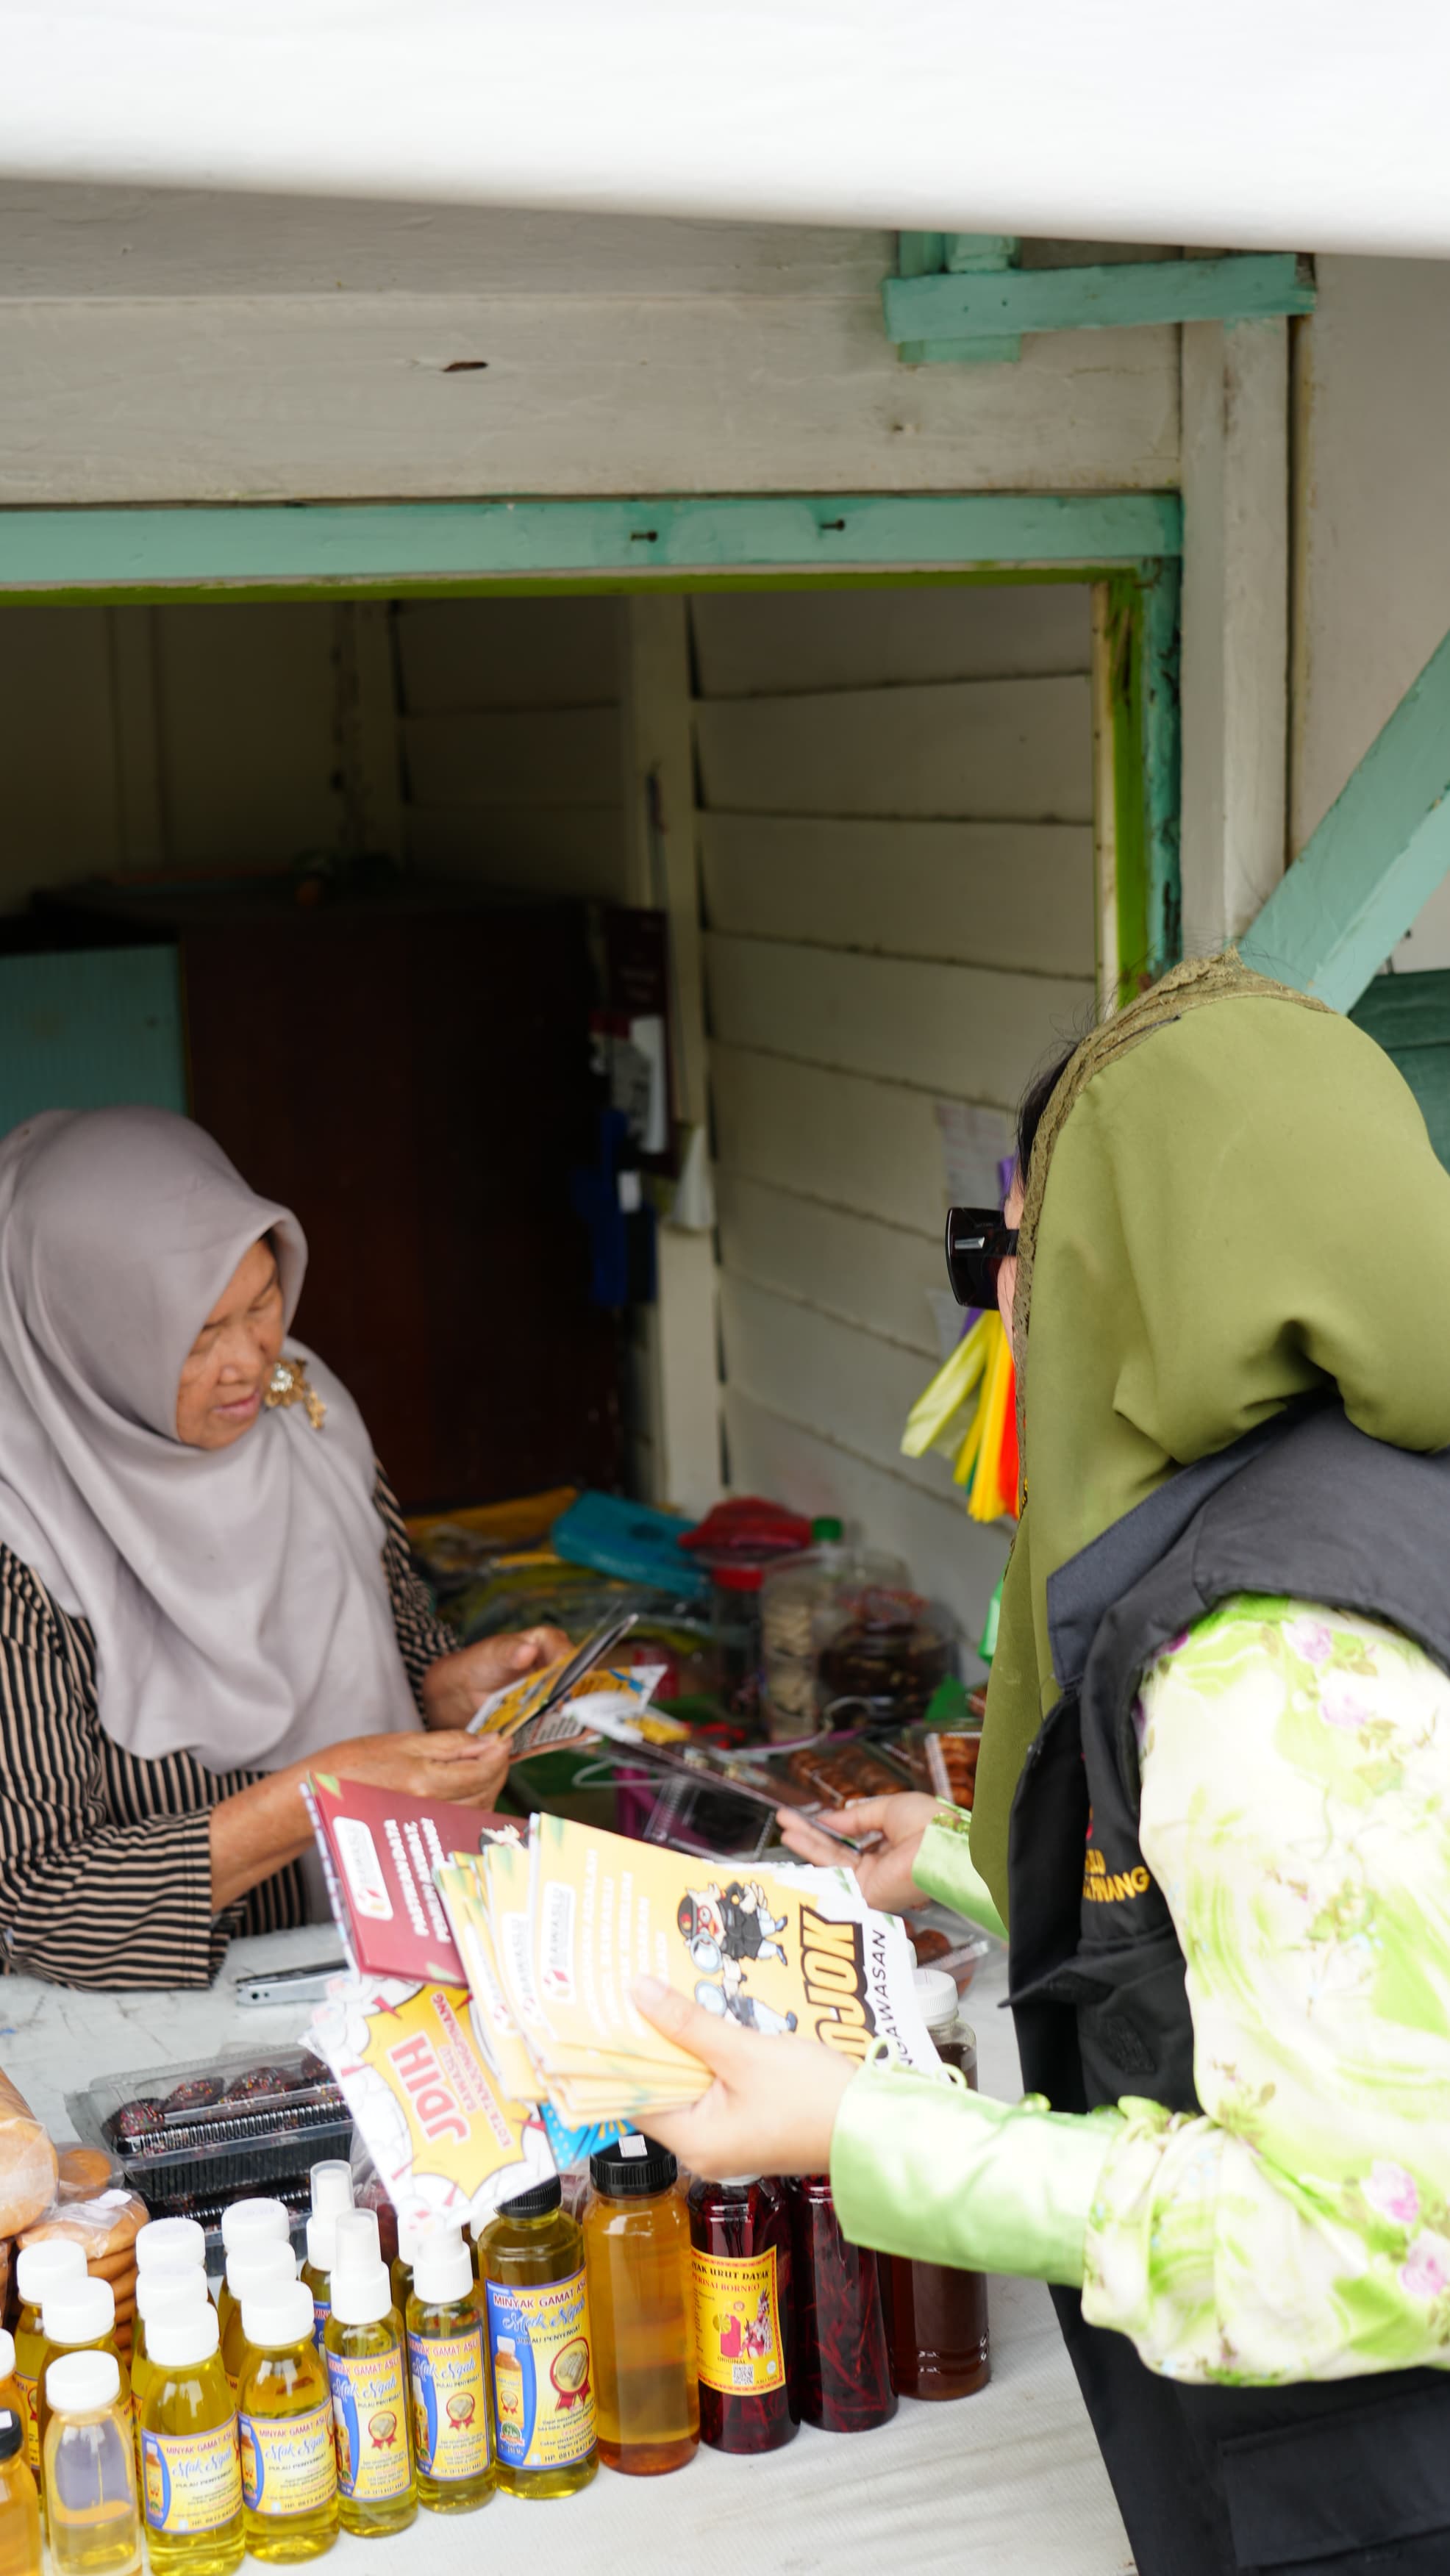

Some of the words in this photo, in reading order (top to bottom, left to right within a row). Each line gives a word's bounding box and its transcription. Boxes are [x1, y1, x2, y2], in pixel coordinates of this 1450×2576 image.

[799, 1903, 876, 2064] OJOK
[390, 2033, 468, 2140] JDIH
[743, 2269, 770, 2281] DAYAK
[721, 2283, 760, 2293] BORNEO
[493, 2293, 535, 2308] MINYAK
[538, 2286, 575, 2308] GAMAT
[501, 2311, 548, 2336] Mak
[432, 2345, 460, 2356] GAMAT
[463, 2339, 479, 2353] ASLI
[354, 2364, 382, 2376] GAMAT
[259, 2430, 286, 2439] MINYAK
[290, 2423, 313, 2438] GAMAT
[166, 2446, 194, 2455] MINYAK
[197, 2437, 221, 2452] GAMAT
